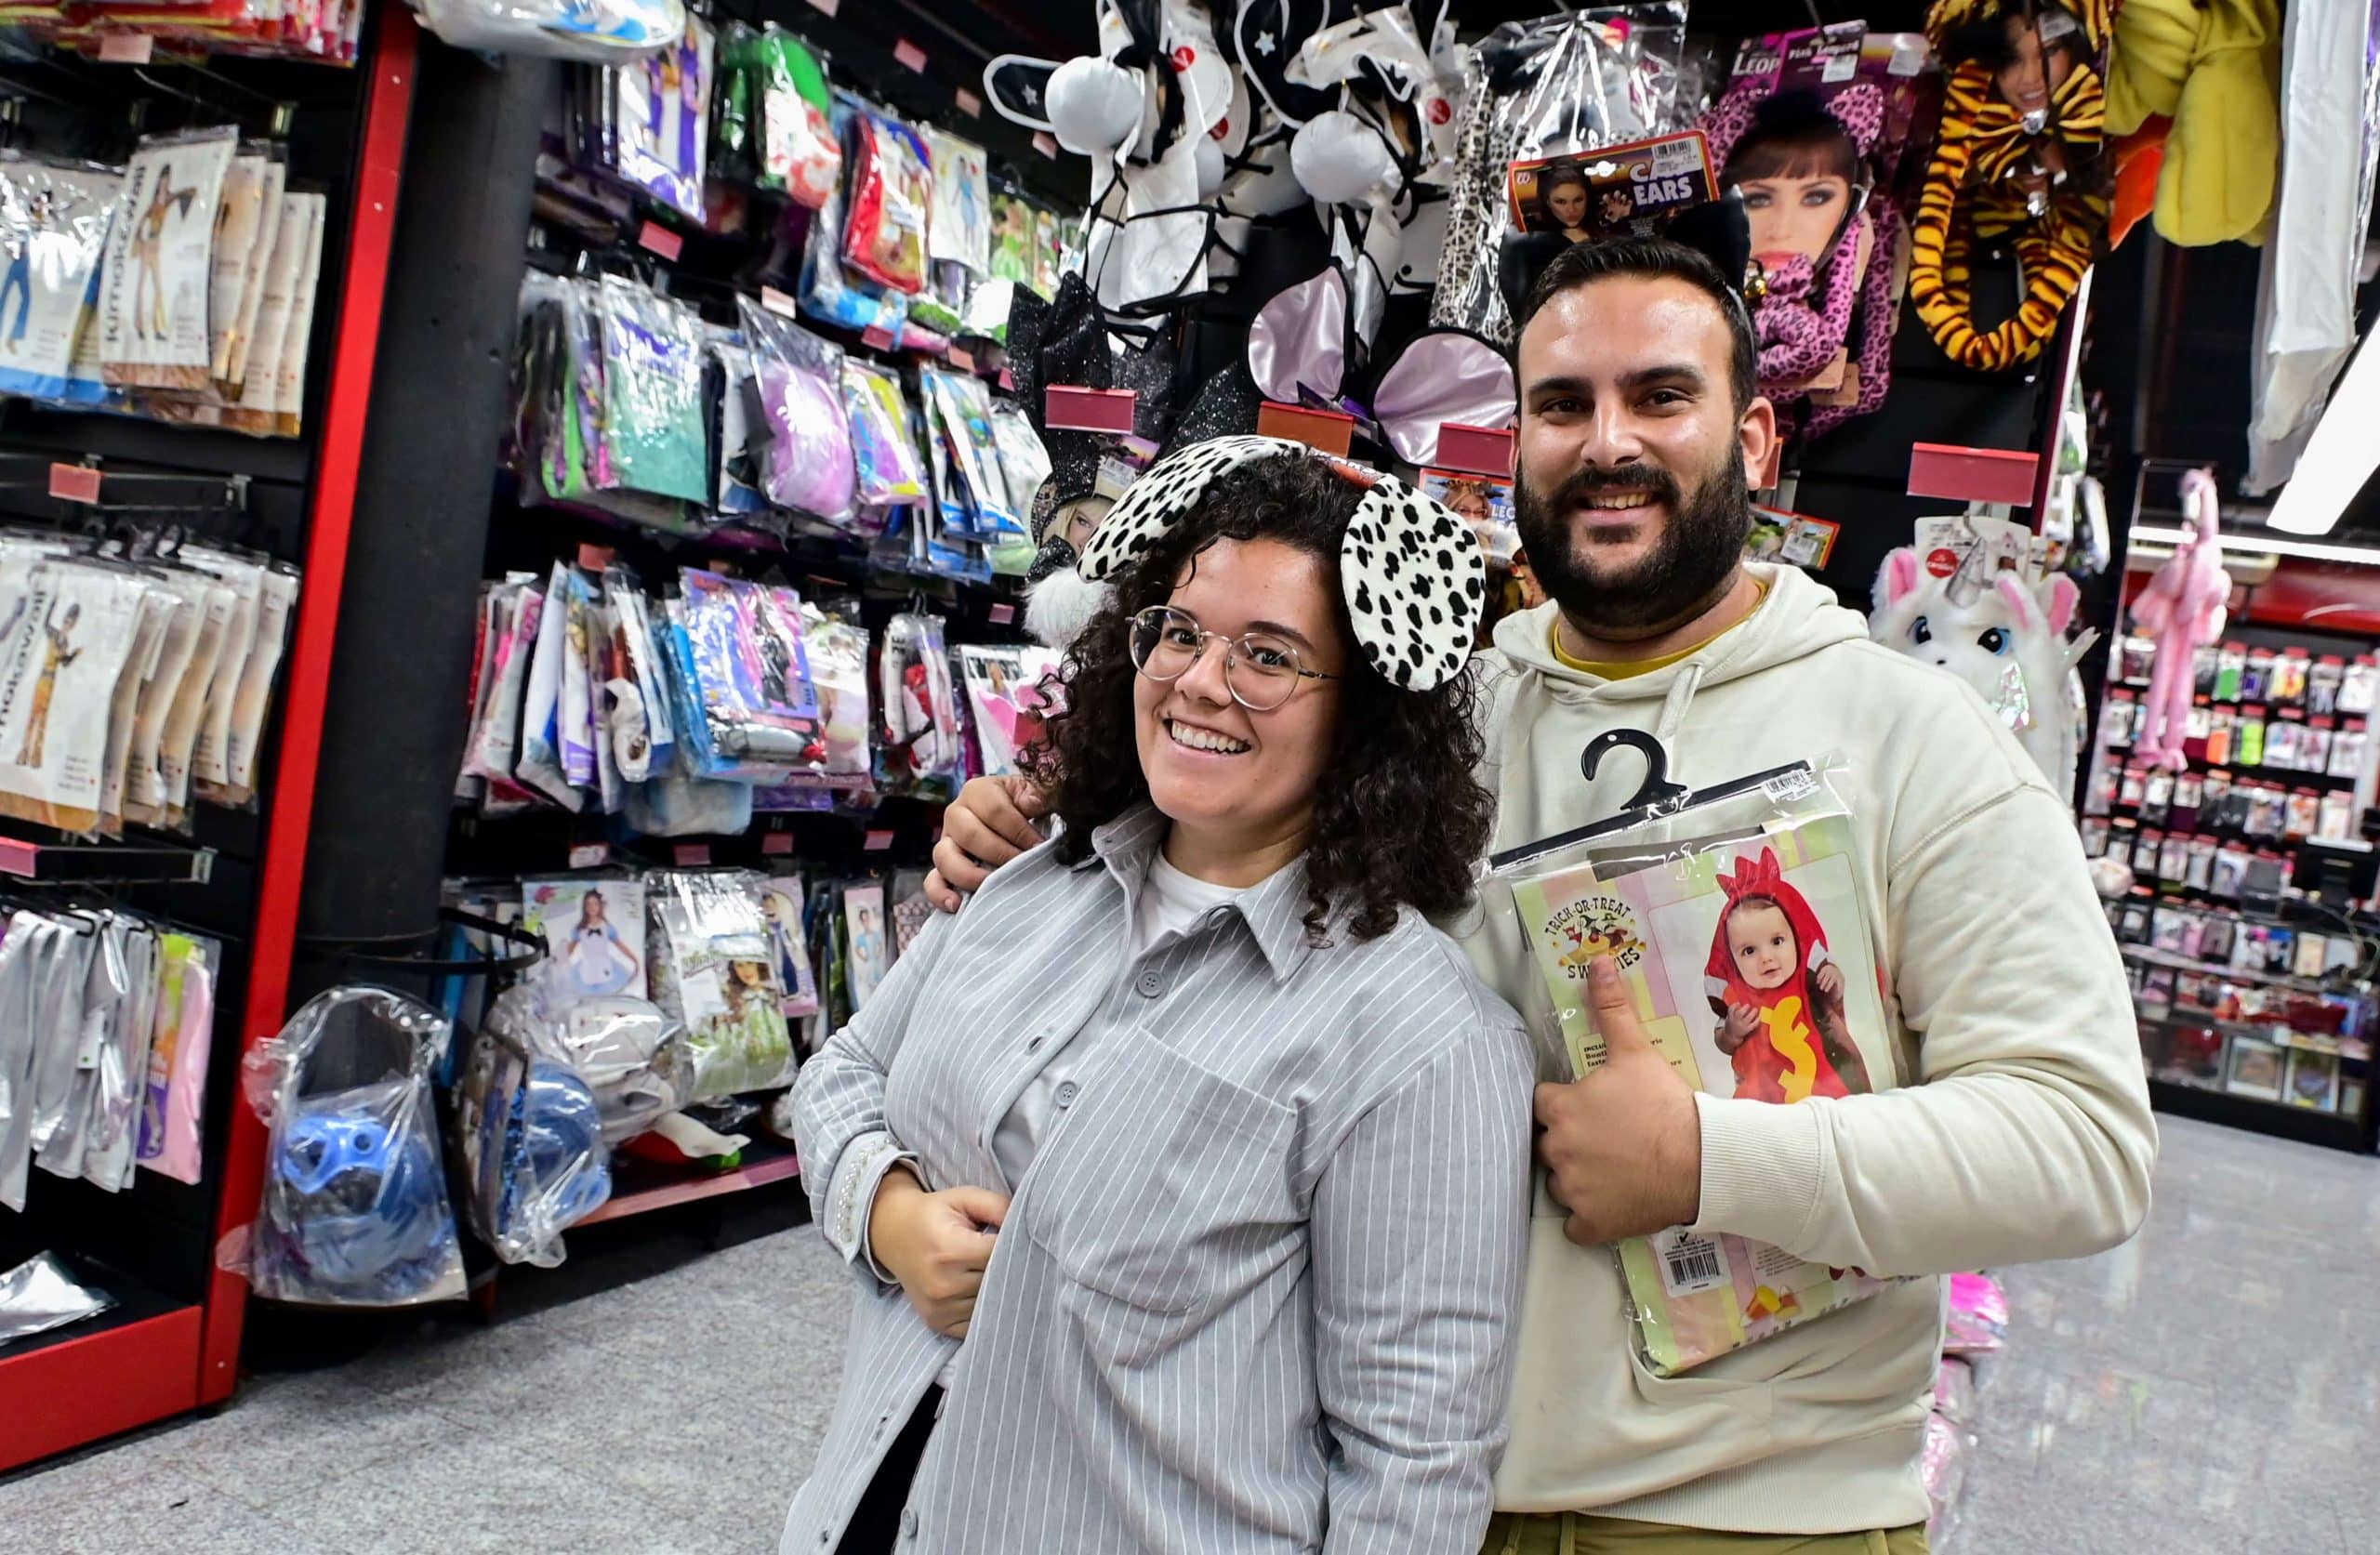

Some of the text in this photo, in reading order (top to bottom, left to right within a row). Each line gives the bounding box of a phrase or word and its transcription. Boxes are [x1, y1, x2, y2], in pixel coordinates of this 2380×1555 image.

[1629, 159, 1685, 183] CA
[1633, 176, 1693, 206] EARS
[1567, 946, 1641, 980] SWIES
